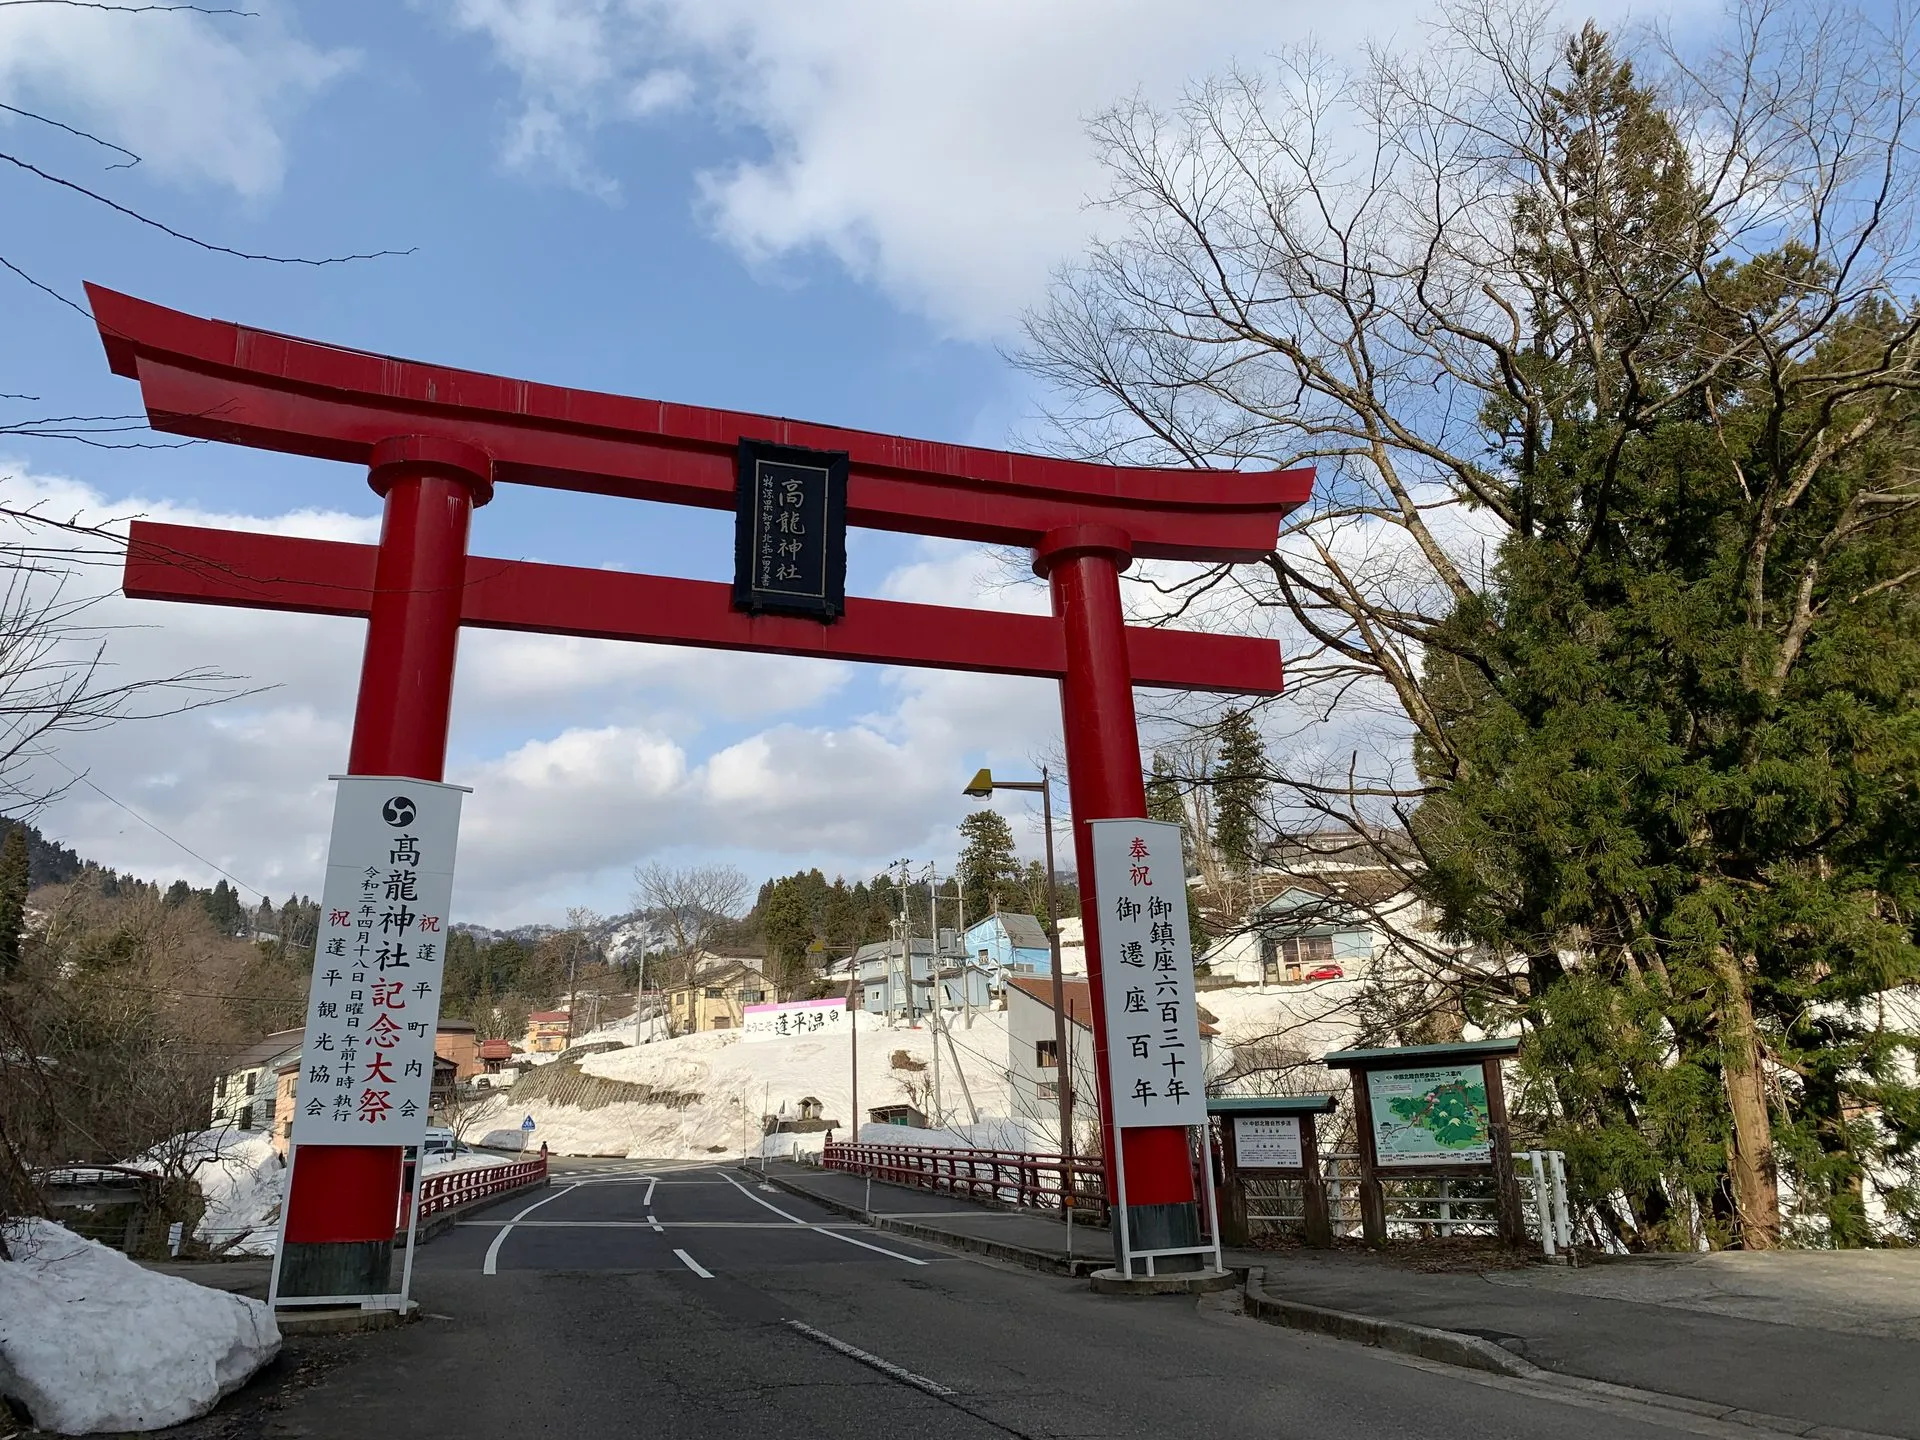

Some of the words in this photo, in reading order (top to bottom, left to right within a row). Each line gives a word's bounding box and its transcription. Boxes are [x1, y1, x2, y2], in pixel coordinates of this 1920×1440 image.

[775, 478, 806, 581] 高龍神社
[1128, 837, 1153, 887] 奉祝
[1115, 896, 1158, 1108] 御遷座百年
[1147, 895, 1190, 1106] 御鎮座六百三十年
